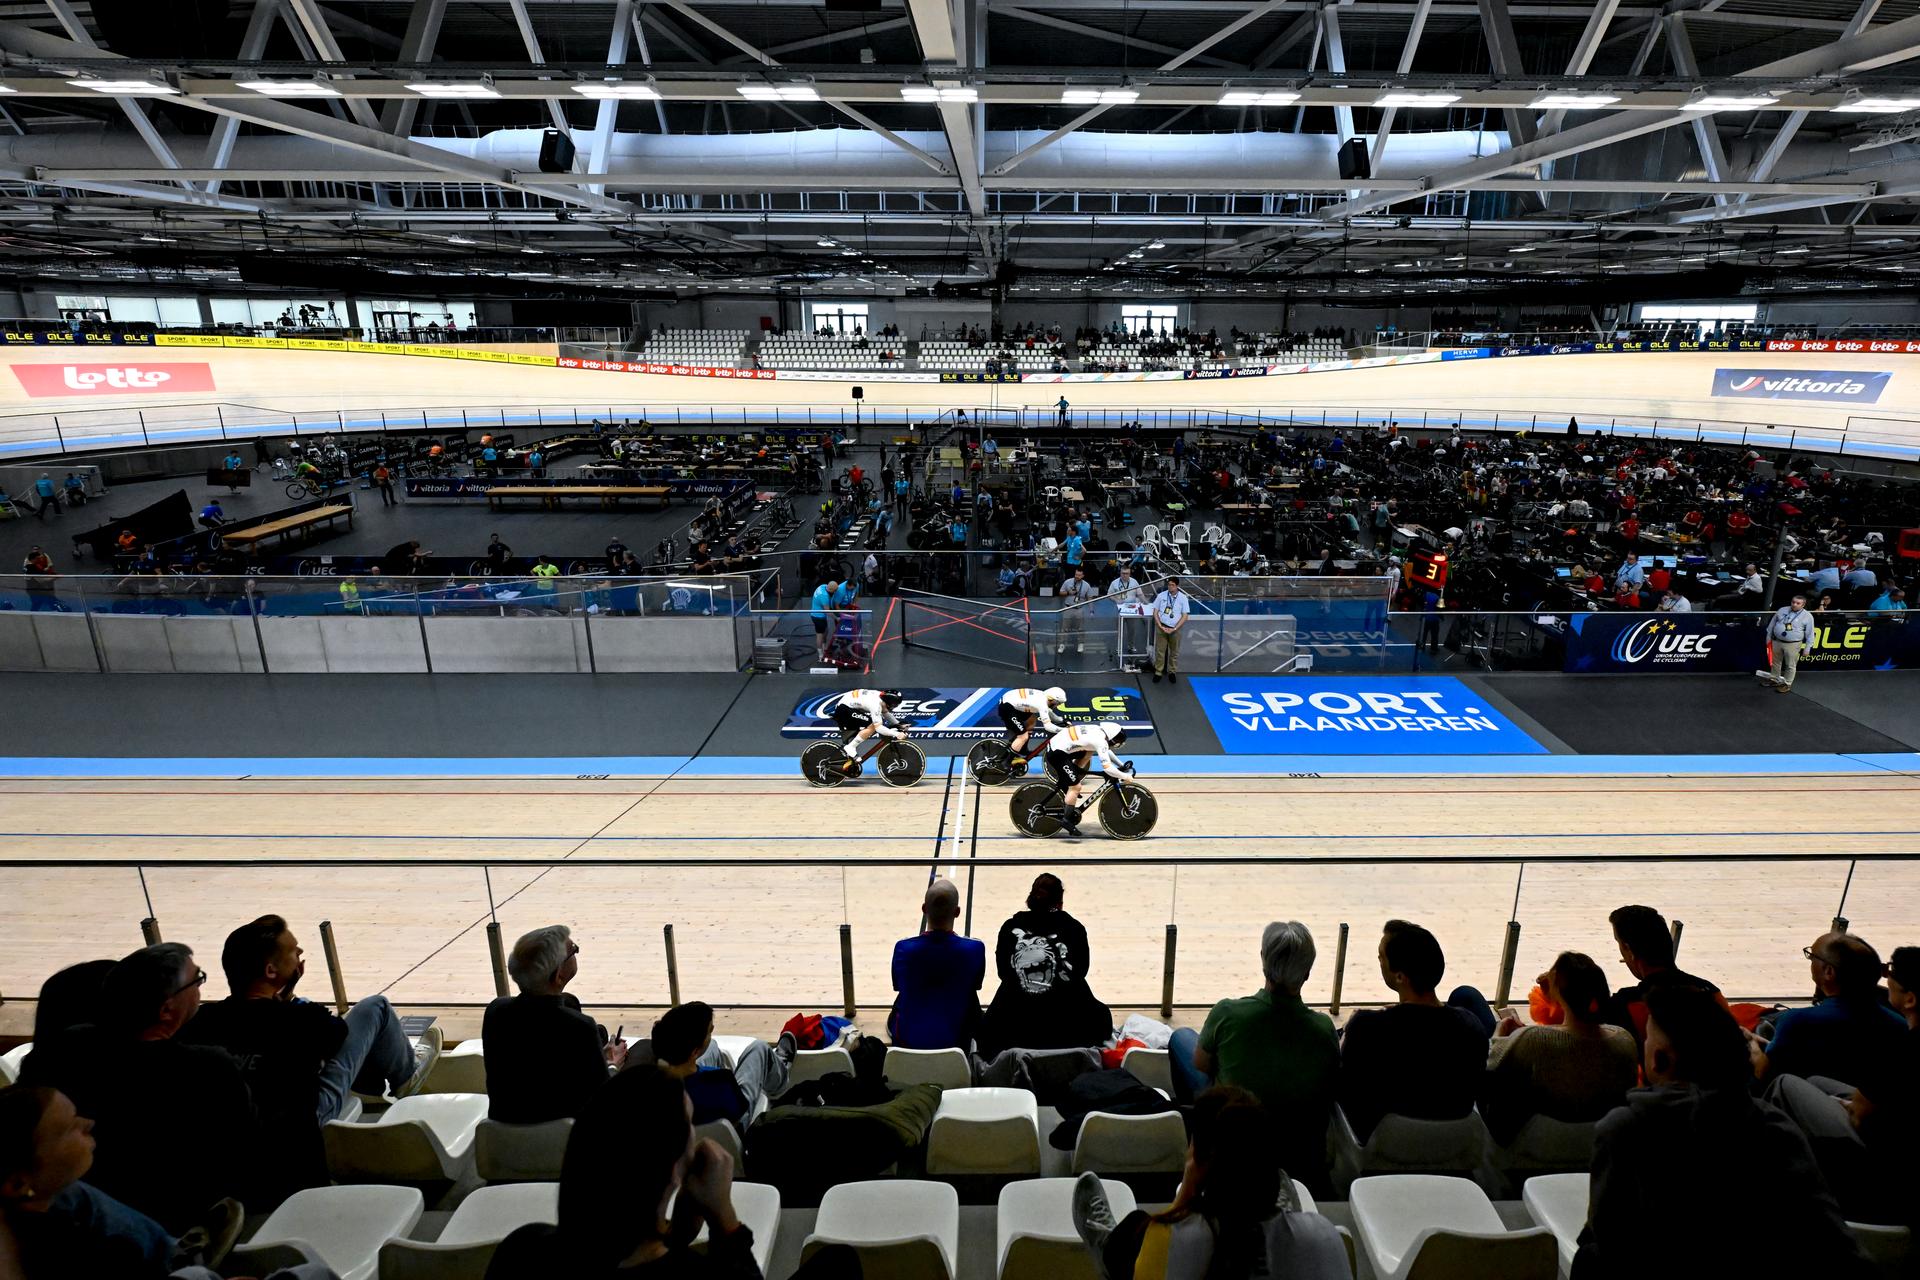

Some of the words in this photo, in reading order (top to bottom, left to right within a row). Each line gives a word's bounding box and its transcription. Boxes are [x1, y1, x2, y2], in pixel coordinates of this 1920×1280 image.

[1769, 341, 1795, 350] lotto
[1802, 341, 1829, 350] lotto
[1835, 341, 1863, 351] lotto
[1870, 341, 1900, 351] lotto
[1196, 370, 1222, 378] vittoria
[1237, 368, 1263, 376] vittoria
[64, 366, 171, 389] lotto
[1764, 377, 1865, 394] vittoria
[312, 566, 336, 575] UEC
[1426, 563, 1438, 579] 3
[1658, 634, 1718, 653] UEC
[1233, 717, 1500, 731] VLAANDEREN
[1083, 780, 1112, 808] LOOK
